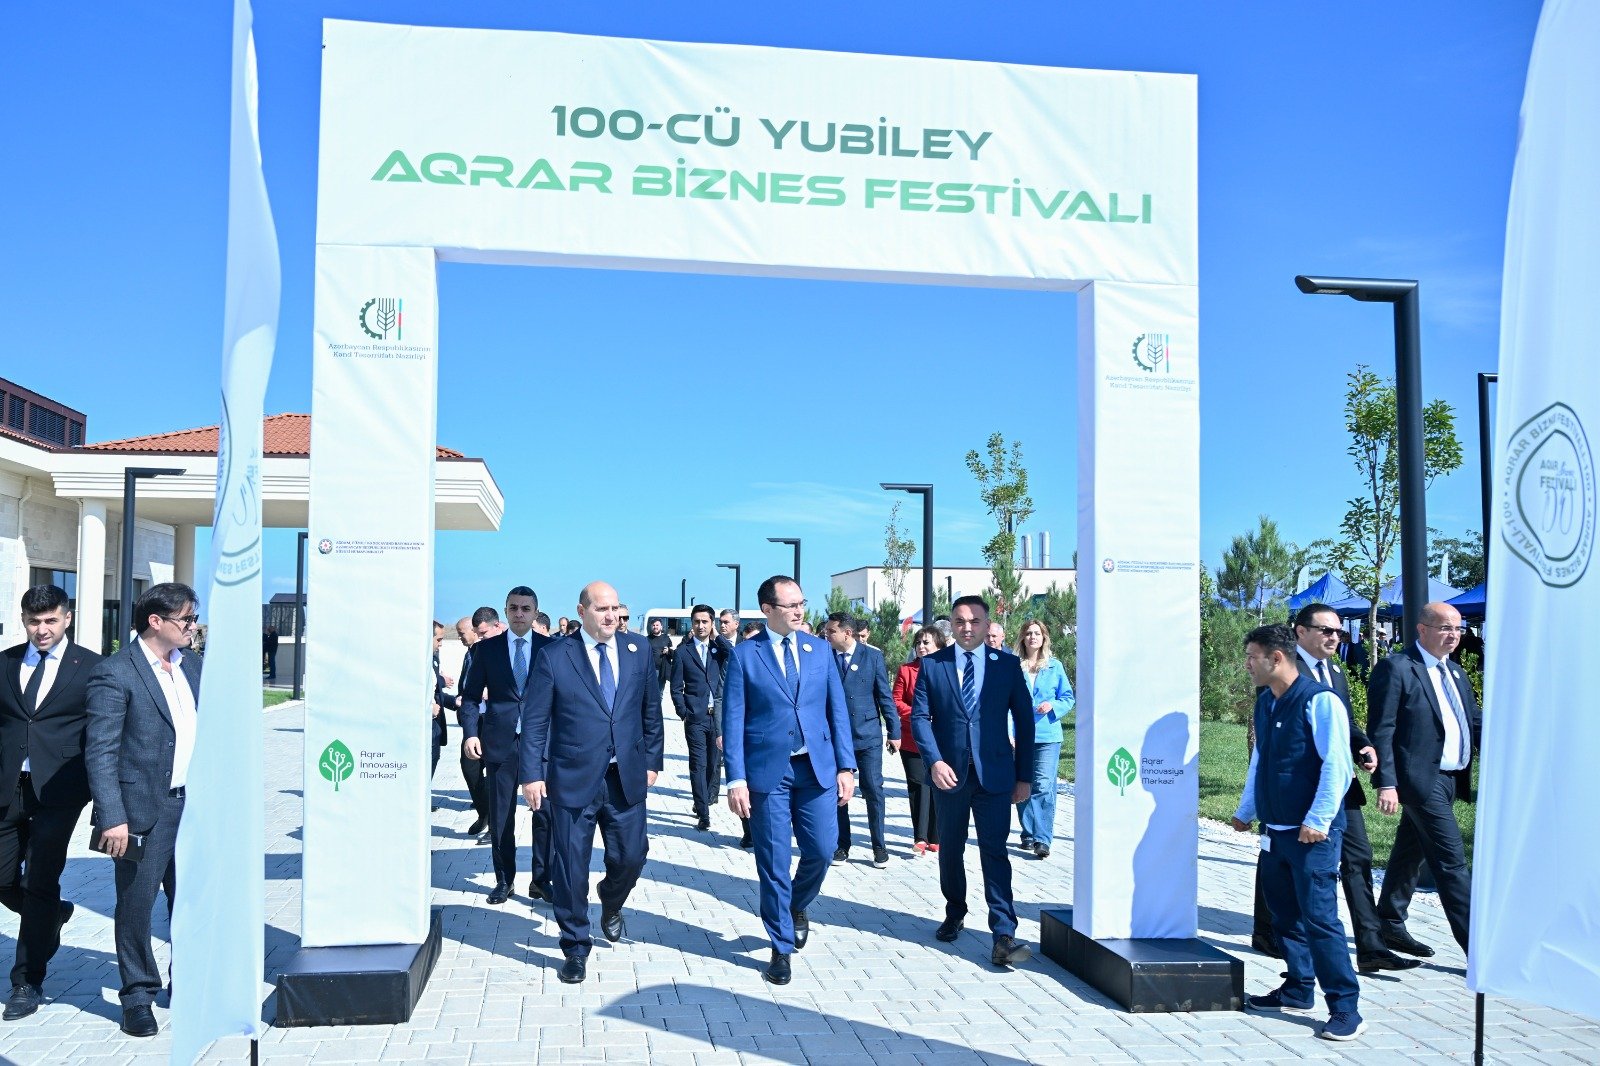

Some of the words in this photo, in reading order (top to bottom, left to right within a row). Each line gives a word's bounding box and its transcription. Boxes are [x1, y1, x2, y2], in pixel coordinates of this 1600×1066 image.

[551, 106, 742, 149] 100-CÜ
[760, 117, 993, 162] YUBİLEY
[371, 150, 614, 195] AQRAR
[633, 158, 848, 208] BİZNES
[865, 178, 1153, 226] FESTİVALI
[360, 750, 386, 760] Aqrar
[359, 759, 408, 770] İnnovasiya
[1141, 757, 1165, 767] Aqrar
[359, 771, 398, 779] Mərkəzi
[1141, 766, 1184, 776] İnnovasiya
[1141, 777, 1175, 785] Mərkəzi
